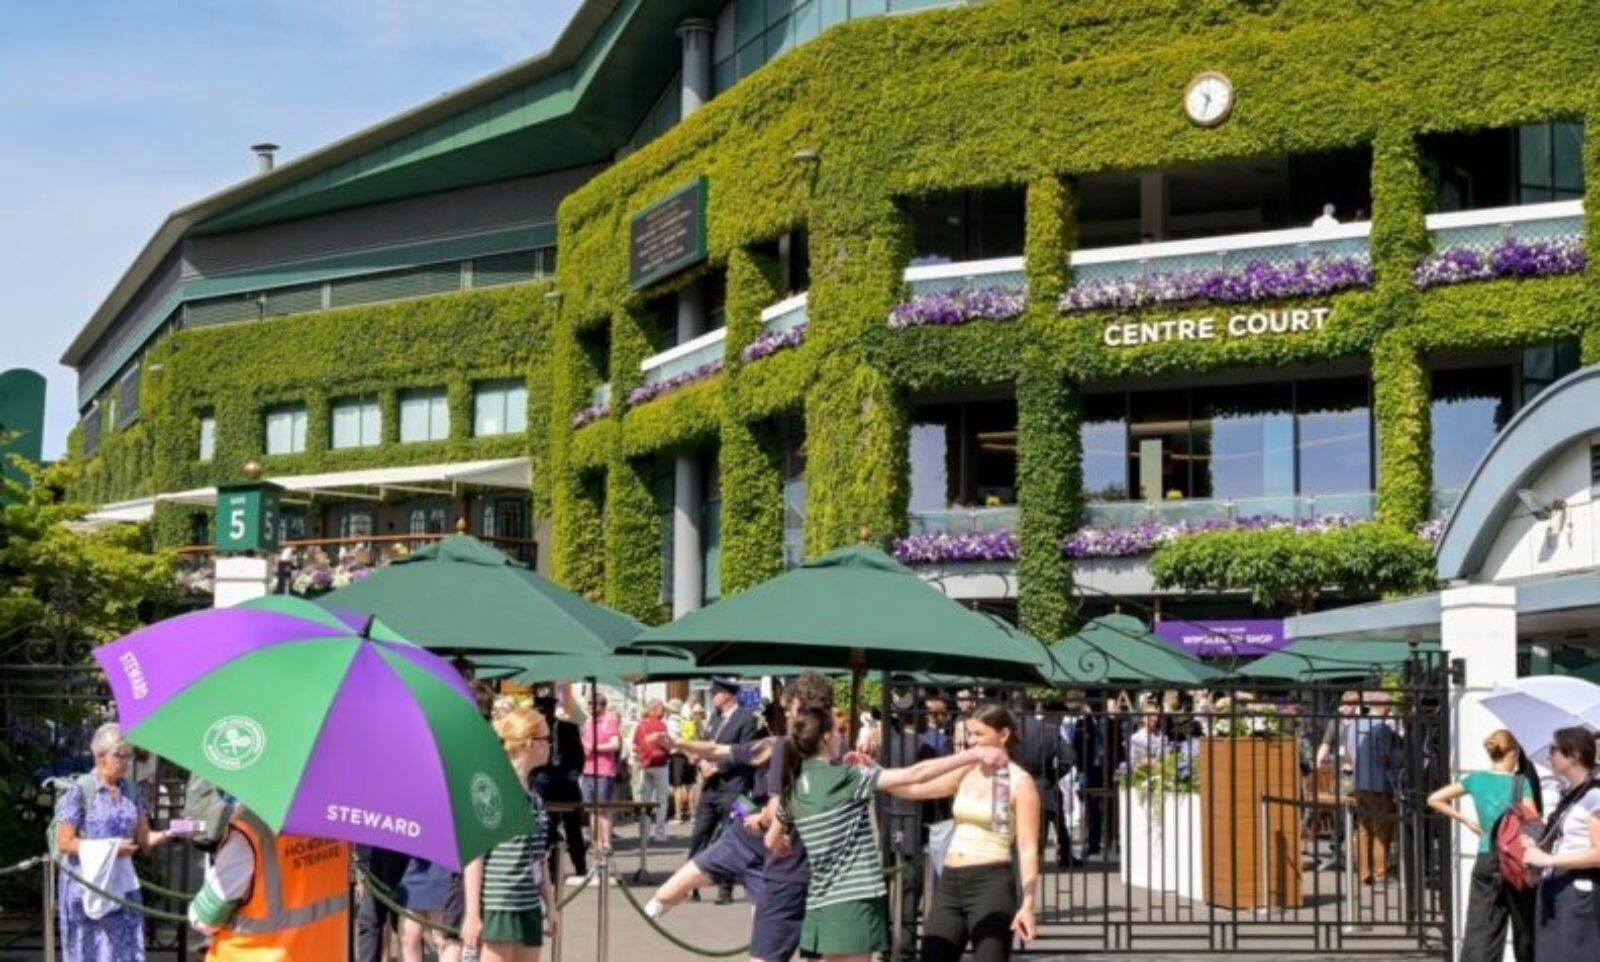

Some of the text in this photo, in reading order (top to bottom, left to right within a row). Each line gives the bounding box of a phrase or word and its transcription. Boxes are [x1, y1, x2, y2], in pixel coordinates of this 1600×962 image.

[1104, 308, 1328, 346] CENTRE COURT
[229, 509, 245, 540] 5
[264, 511, 273, 541] 5
[1245, 634, 1273, 644] SHOP
[119, 651, 148, 700] STEWARD
[326, 804, 421, 838] STEWARD
